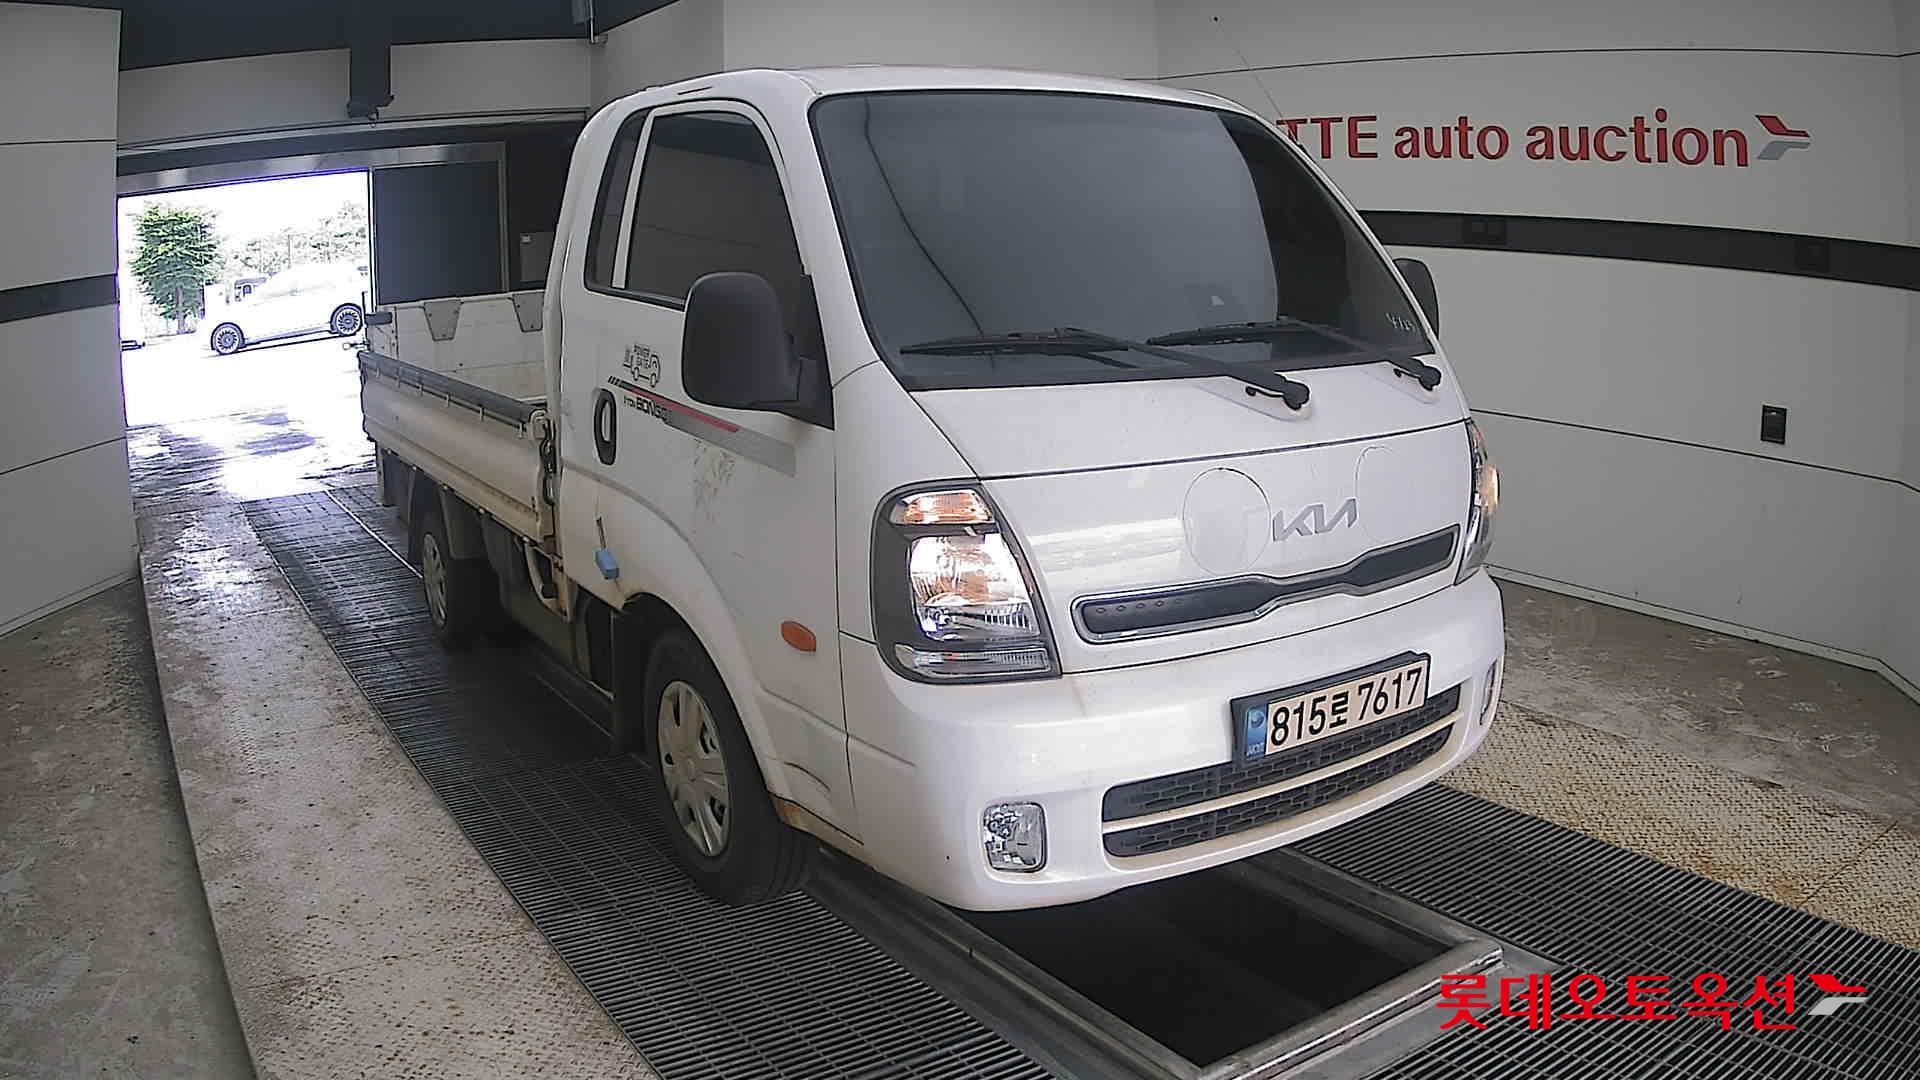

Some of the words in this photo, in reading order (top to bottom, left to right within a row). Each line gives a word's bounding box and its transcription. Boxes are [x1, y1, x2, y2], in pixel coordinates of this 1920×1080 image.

[1394, 115, 1510, 160] auto
[1525, 109, 1749, 168] auction
[1272, 498, 1357, 541] KIA
[1271, 692, 1349, 746] 815로
[1358, 667, 1422, 720] 7617
